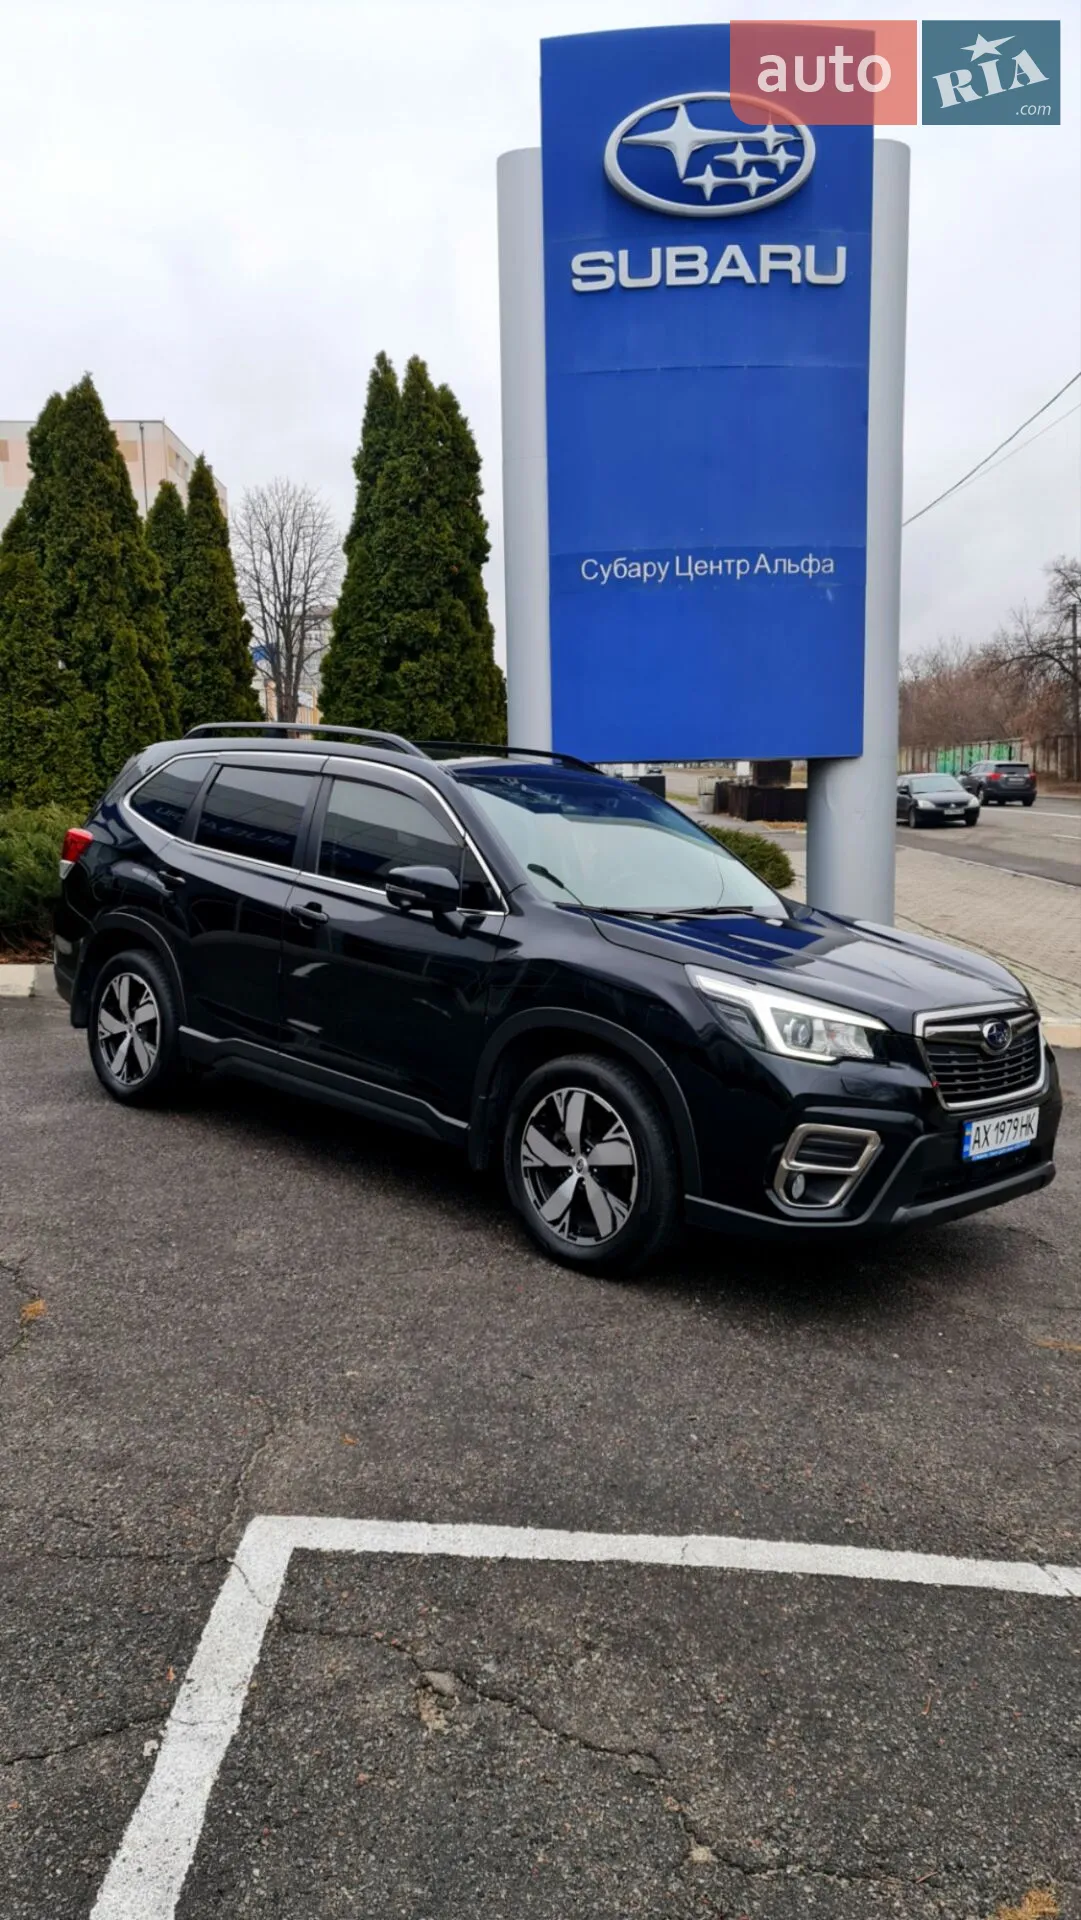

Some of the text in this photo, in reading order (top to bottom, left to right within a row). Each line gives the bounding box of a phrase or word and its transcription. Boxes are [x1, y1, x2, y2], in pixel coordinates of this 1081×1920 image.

[571, 244, 847, 292] SUBARU
[581, 553, 835, 585] Субару Центр Альфа
[971, 1123, 992, 1150] AX
[994, 1117, 1019, 1144] 1979
[1019, 1111, 1036, 1137] HK
